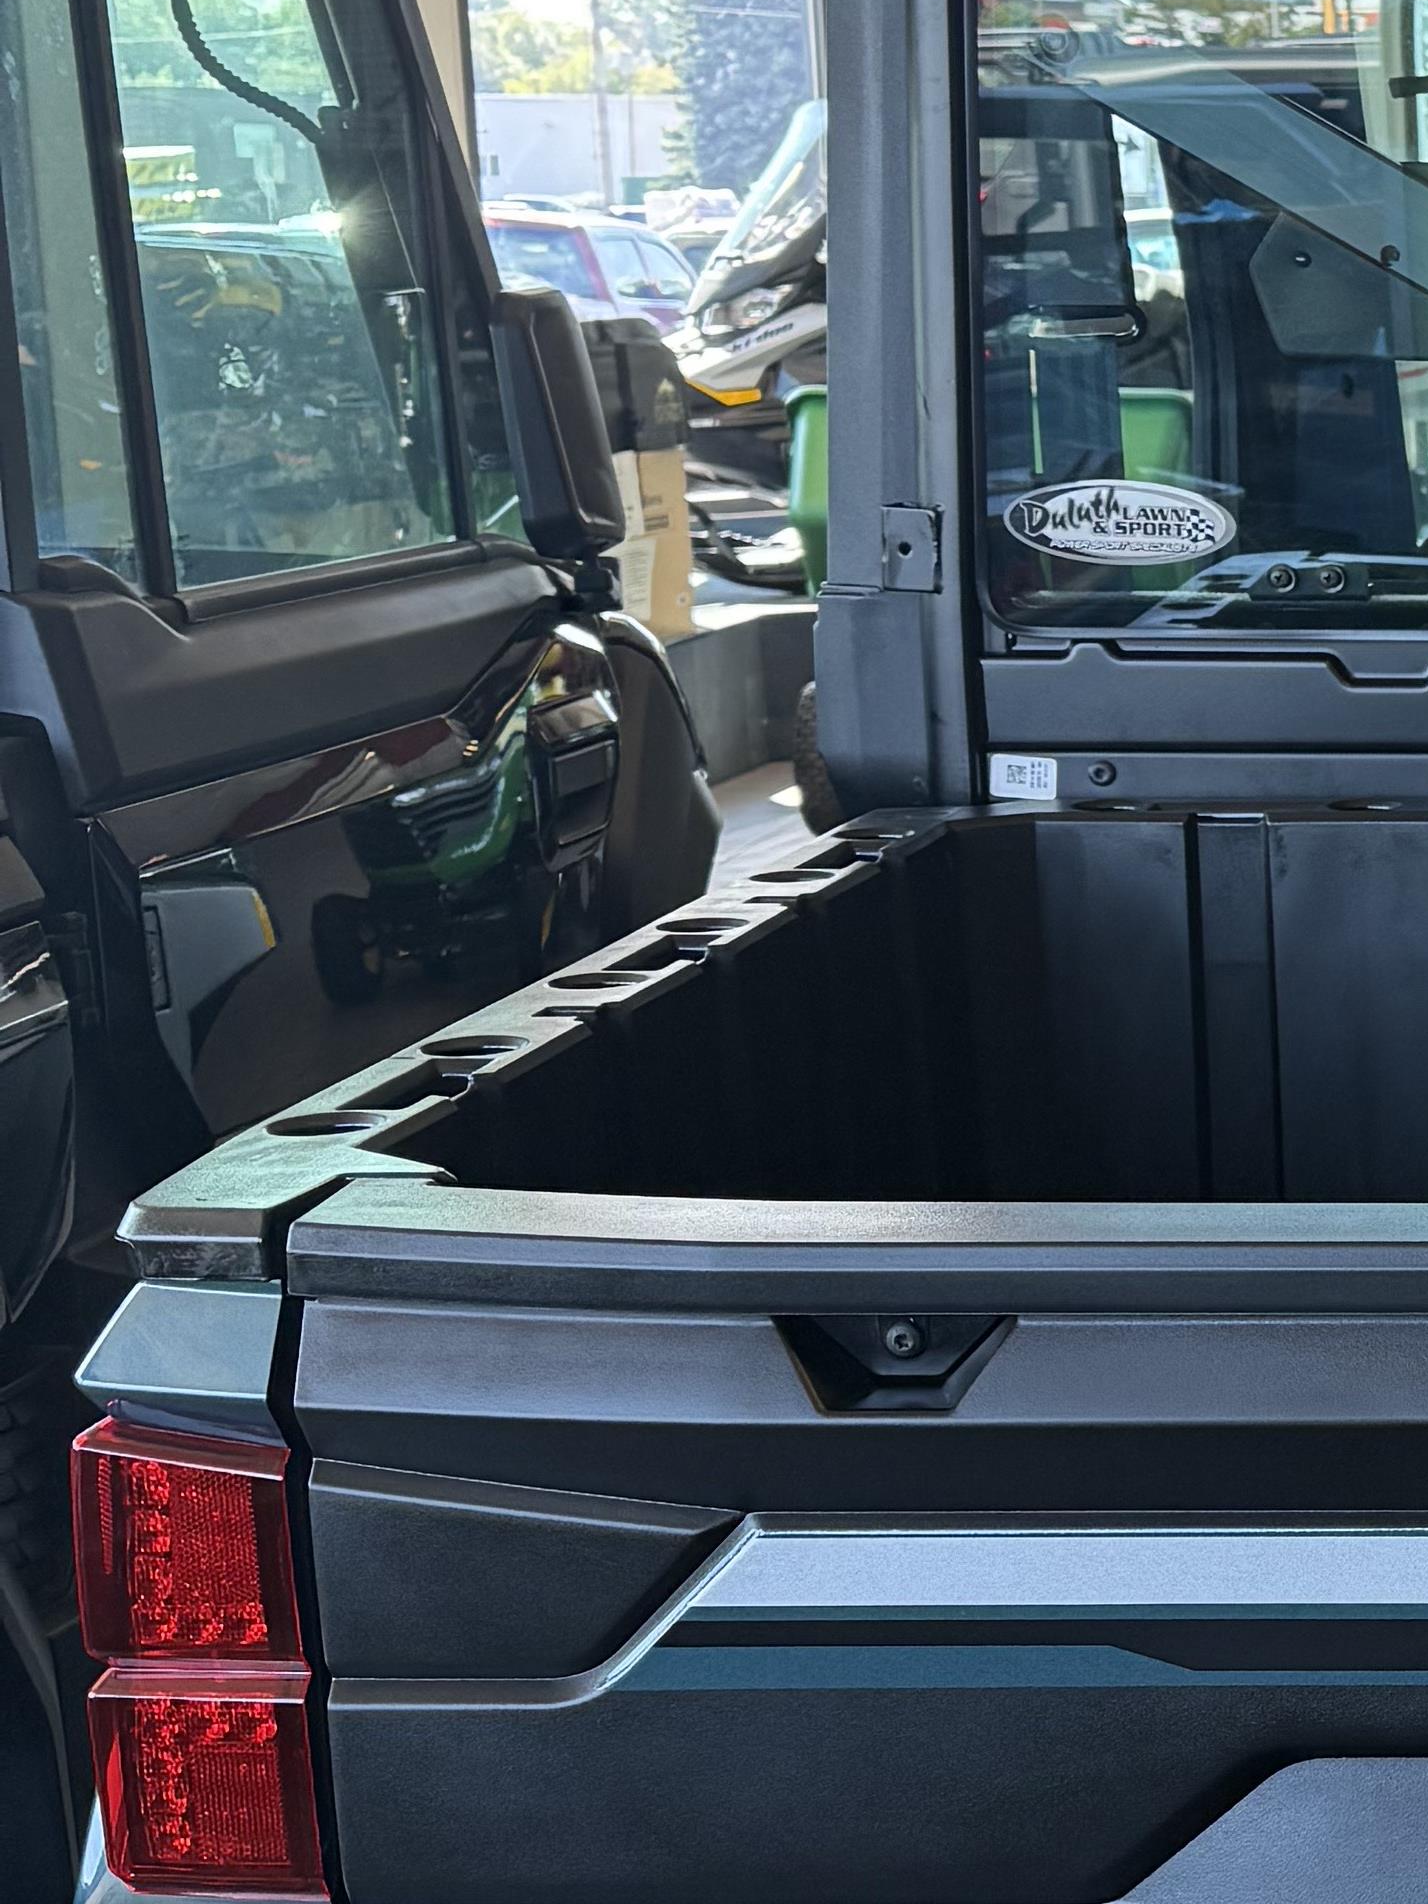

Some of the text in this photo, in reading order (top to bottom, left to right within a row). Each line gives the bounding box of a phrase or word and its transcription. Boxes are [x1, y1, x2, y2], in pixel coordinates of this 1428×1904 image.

[1019, 486, 1186, 537] Duluth LAWN
[1092, 520, 1188, 536] & SPORT
